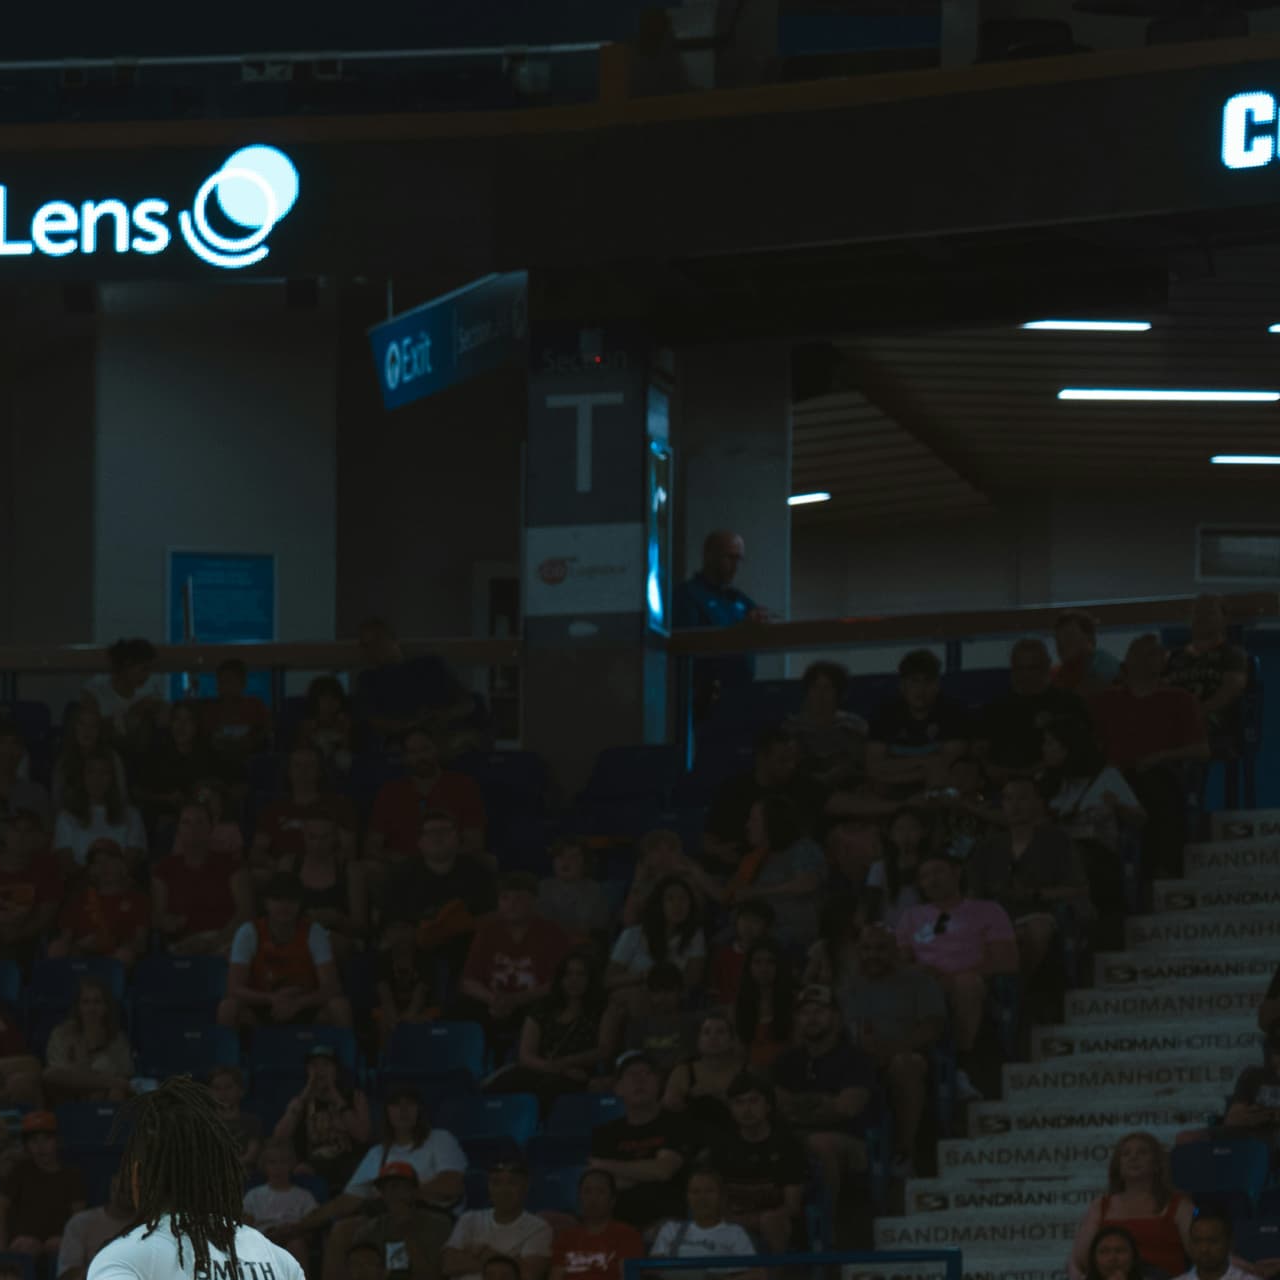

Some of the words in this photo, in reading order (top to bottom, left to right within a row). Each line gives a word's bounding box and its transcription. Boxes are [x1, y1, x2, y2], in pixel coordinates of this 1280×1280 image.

[1221, 90, 1280, 169] C
[400, 331, 432, 384] Exit
[545, 391, 624, 493] T
